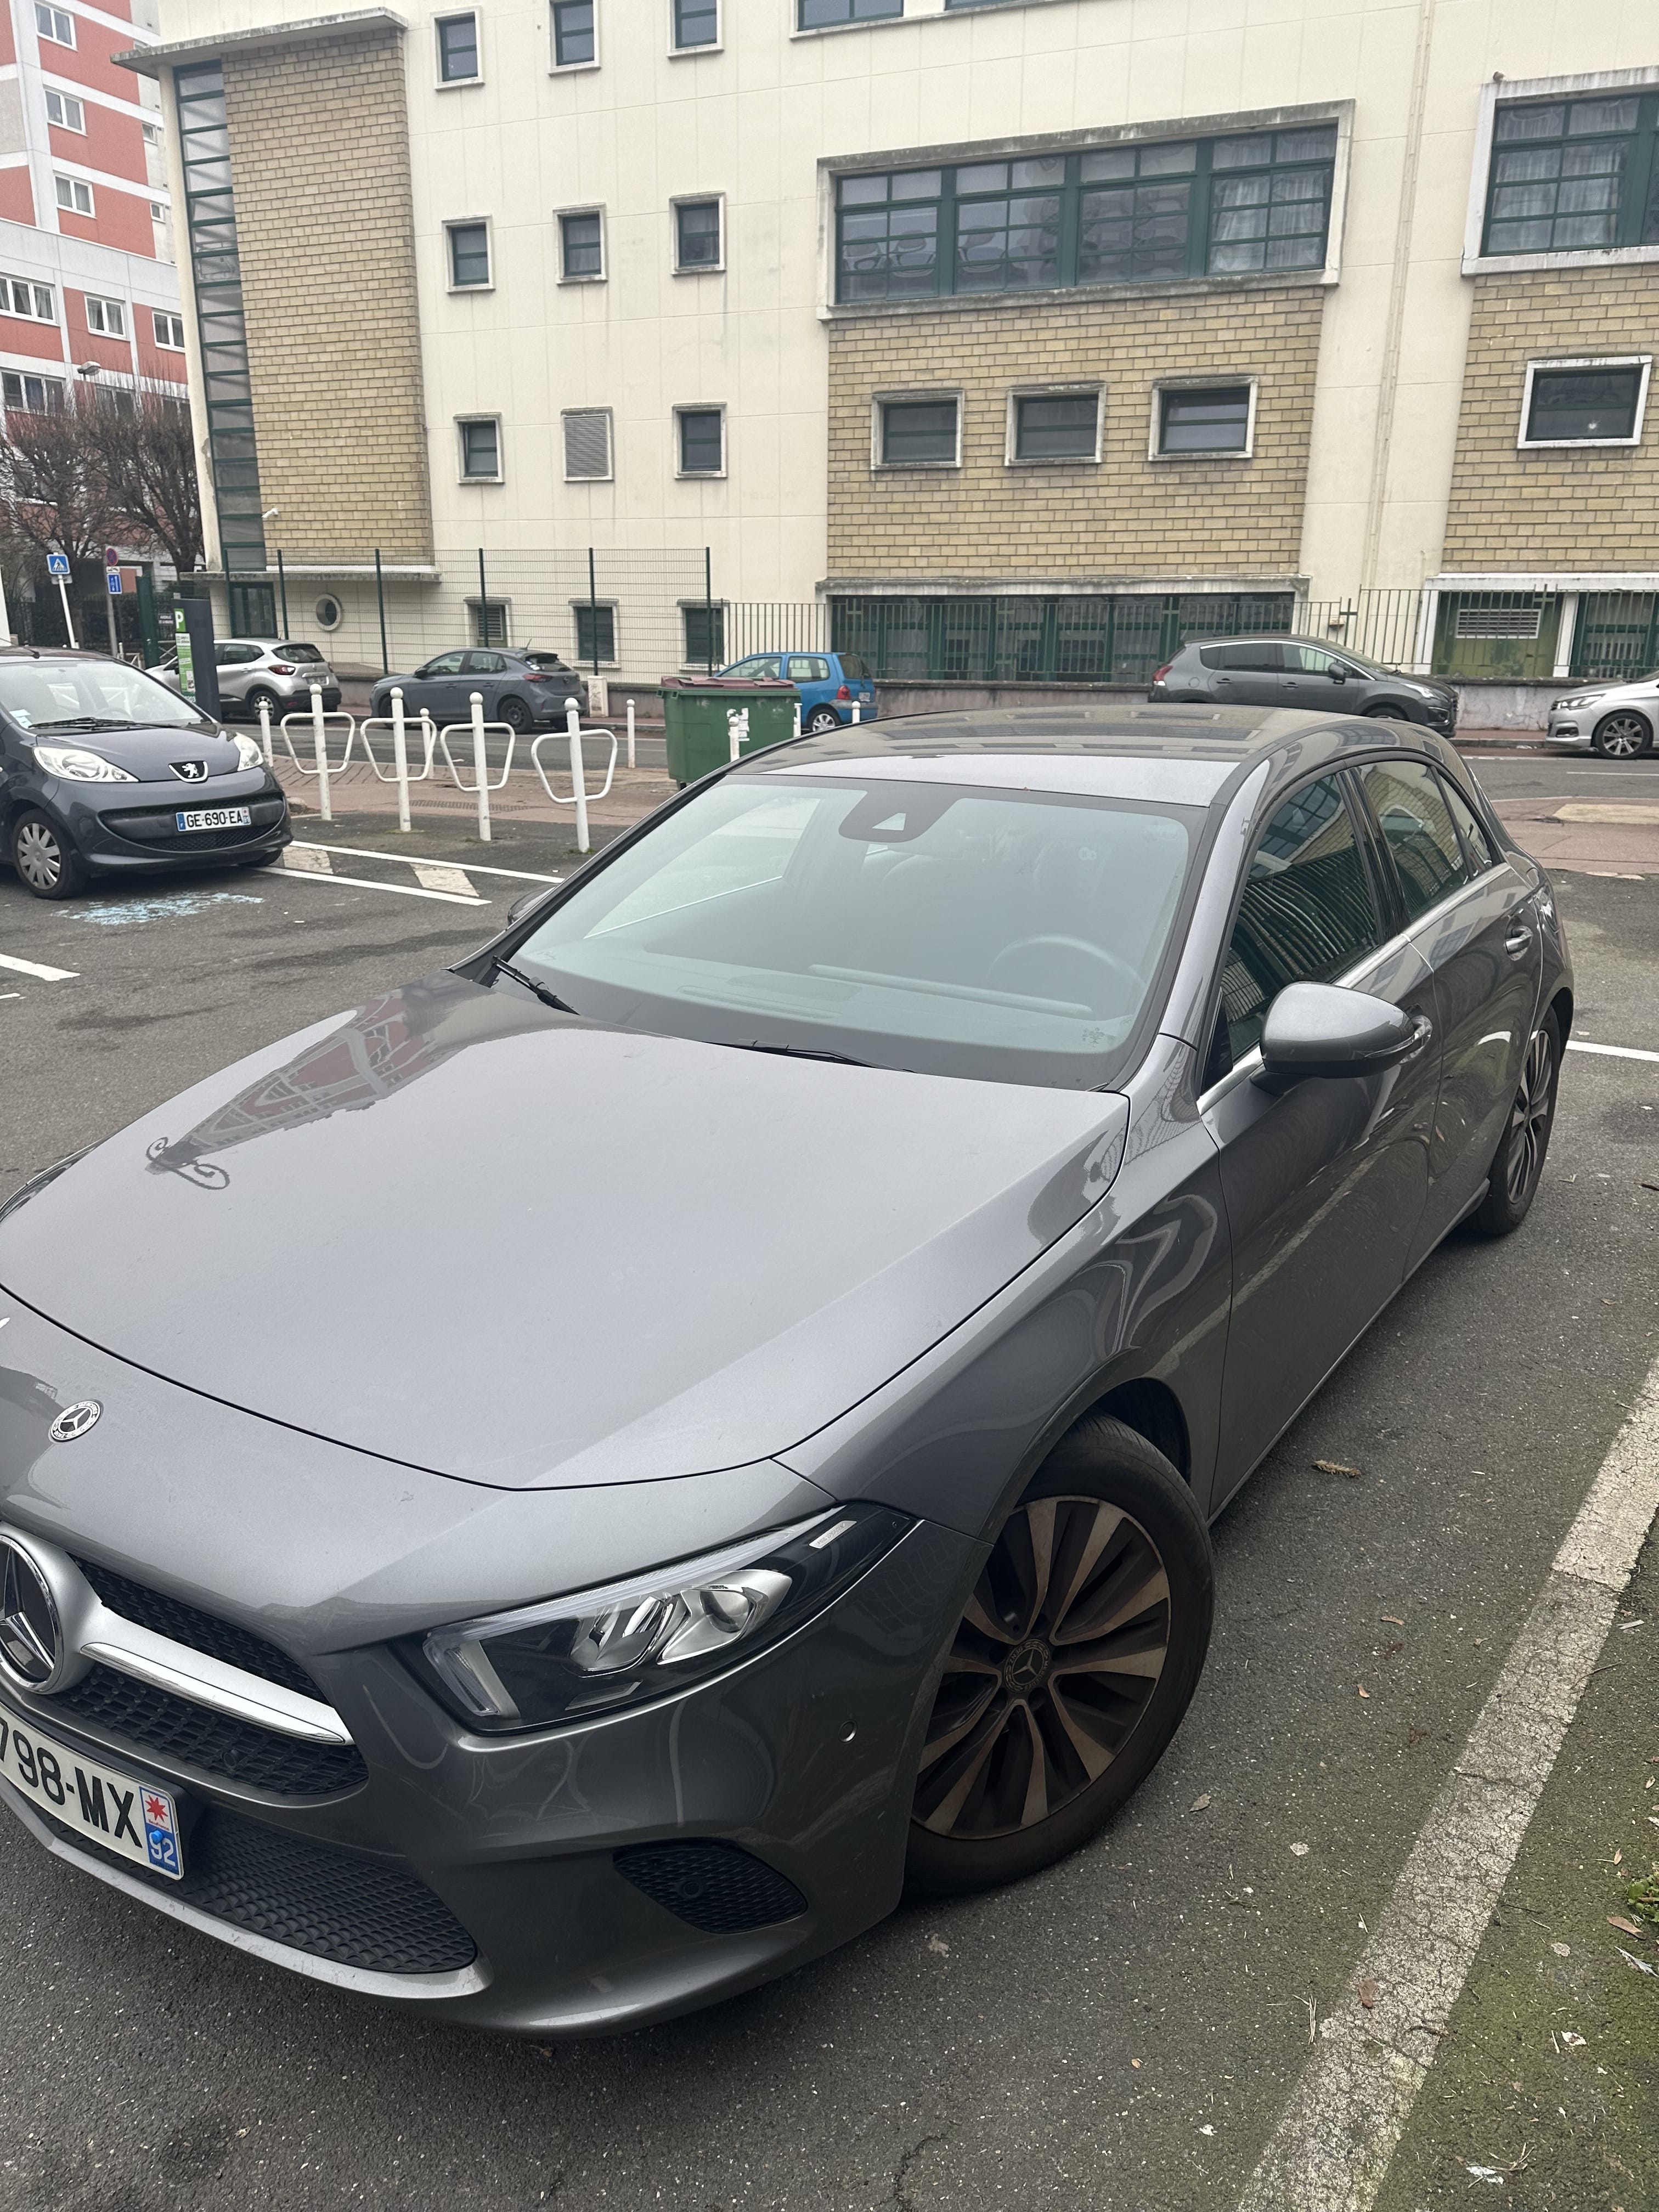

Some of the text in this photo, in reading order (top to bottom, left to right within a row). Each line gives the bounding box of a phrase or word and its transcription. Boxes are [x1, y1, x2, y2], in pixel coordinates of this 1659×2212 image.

[175, 611, 184, 629] P
[187, 810, 242, 827] GE-690-EA
[149, 1832, 176, 1866] 92
